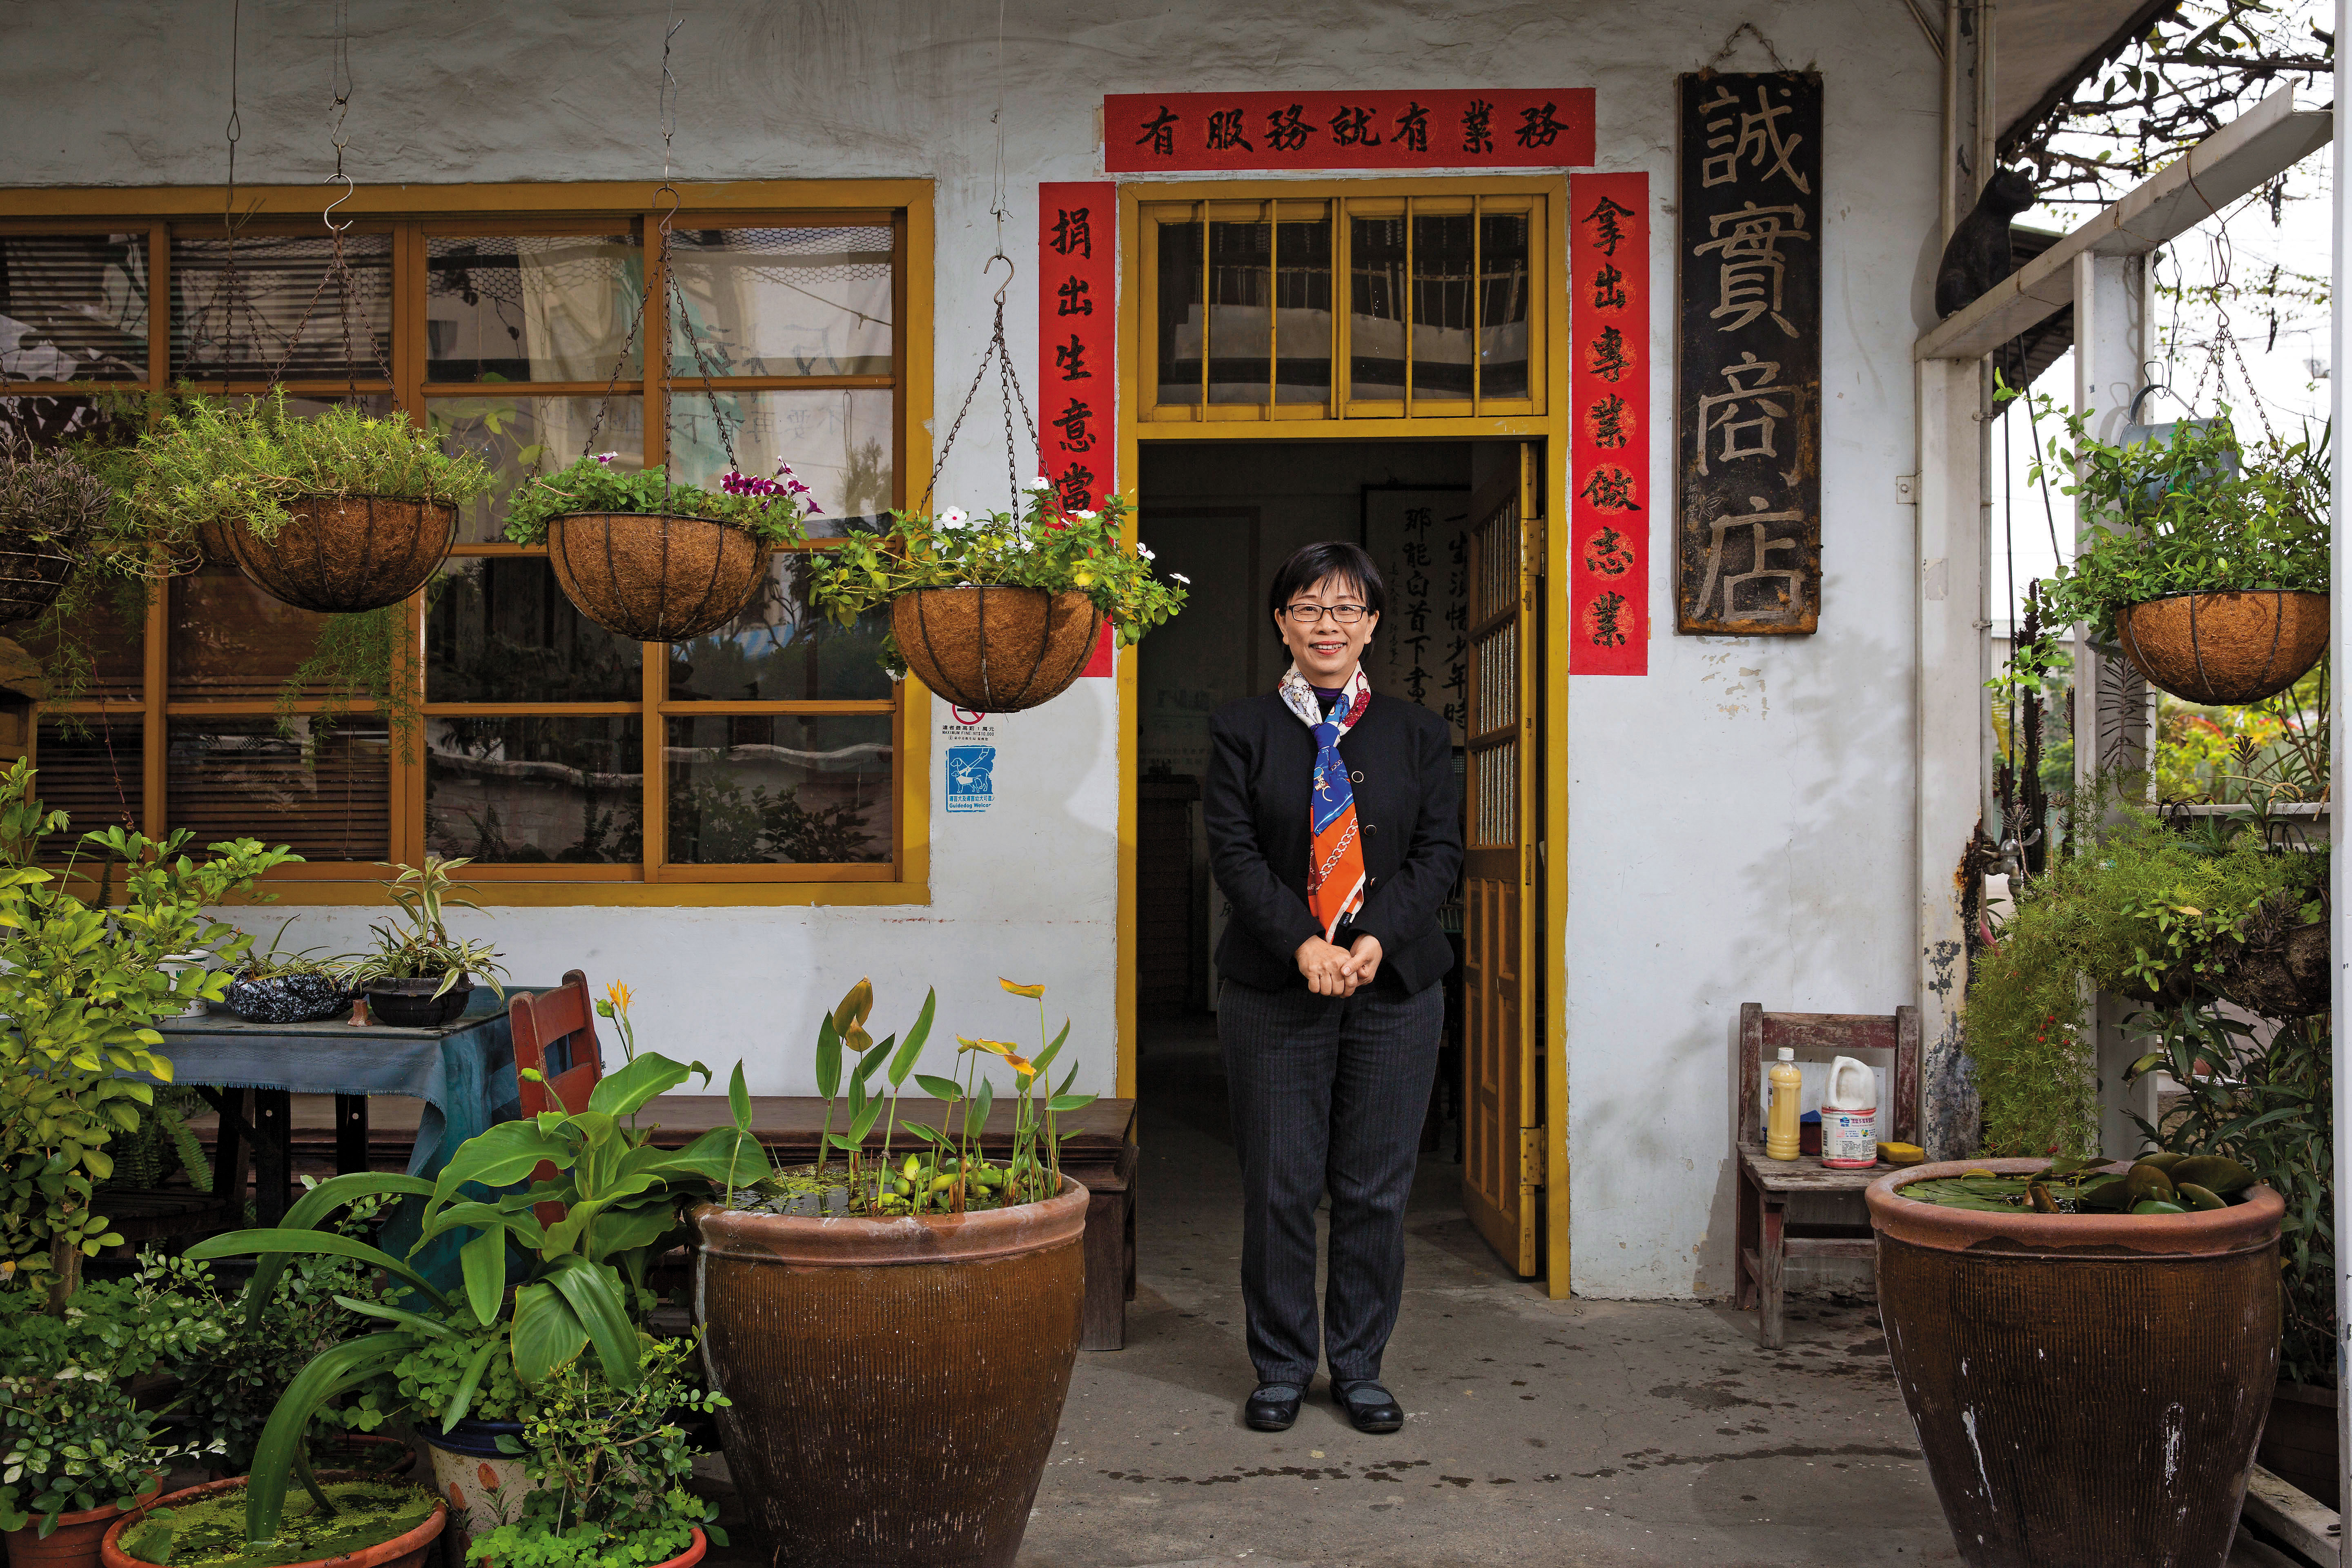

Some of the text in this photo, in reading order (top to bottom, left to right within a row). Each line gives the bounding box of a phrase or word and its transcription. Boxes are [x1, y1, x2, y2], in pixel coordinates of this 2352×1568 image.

[1136, 99, 1570, 154] 有服務就有業務
[1694, 85, 1811, 622] 誠實商店
[1401, 507, 1433, 706] 那能白首下書
